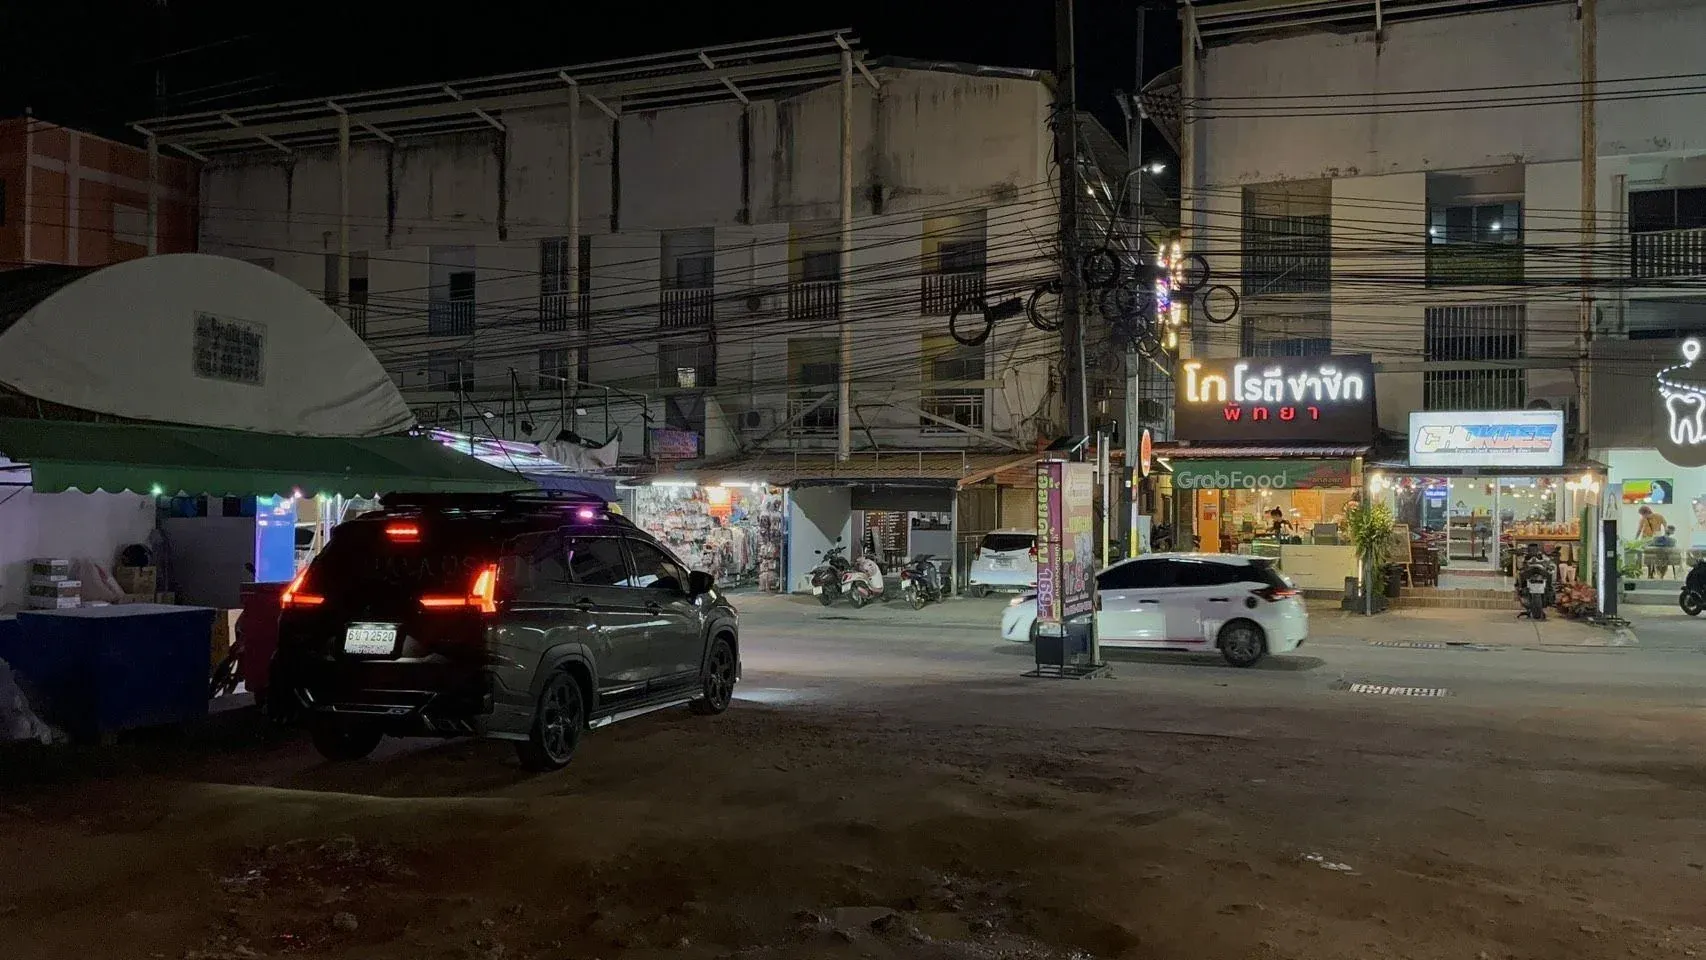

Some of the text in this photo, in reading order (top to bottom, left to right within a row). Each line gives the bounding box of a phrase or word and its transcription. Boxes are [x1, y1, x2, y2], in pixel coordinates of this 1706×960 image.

[1184, 362, 1227, 402] โก
[1223, 402, 1320, 421] พัทยา
[1177, 470, 1287, 489] GrabFood
